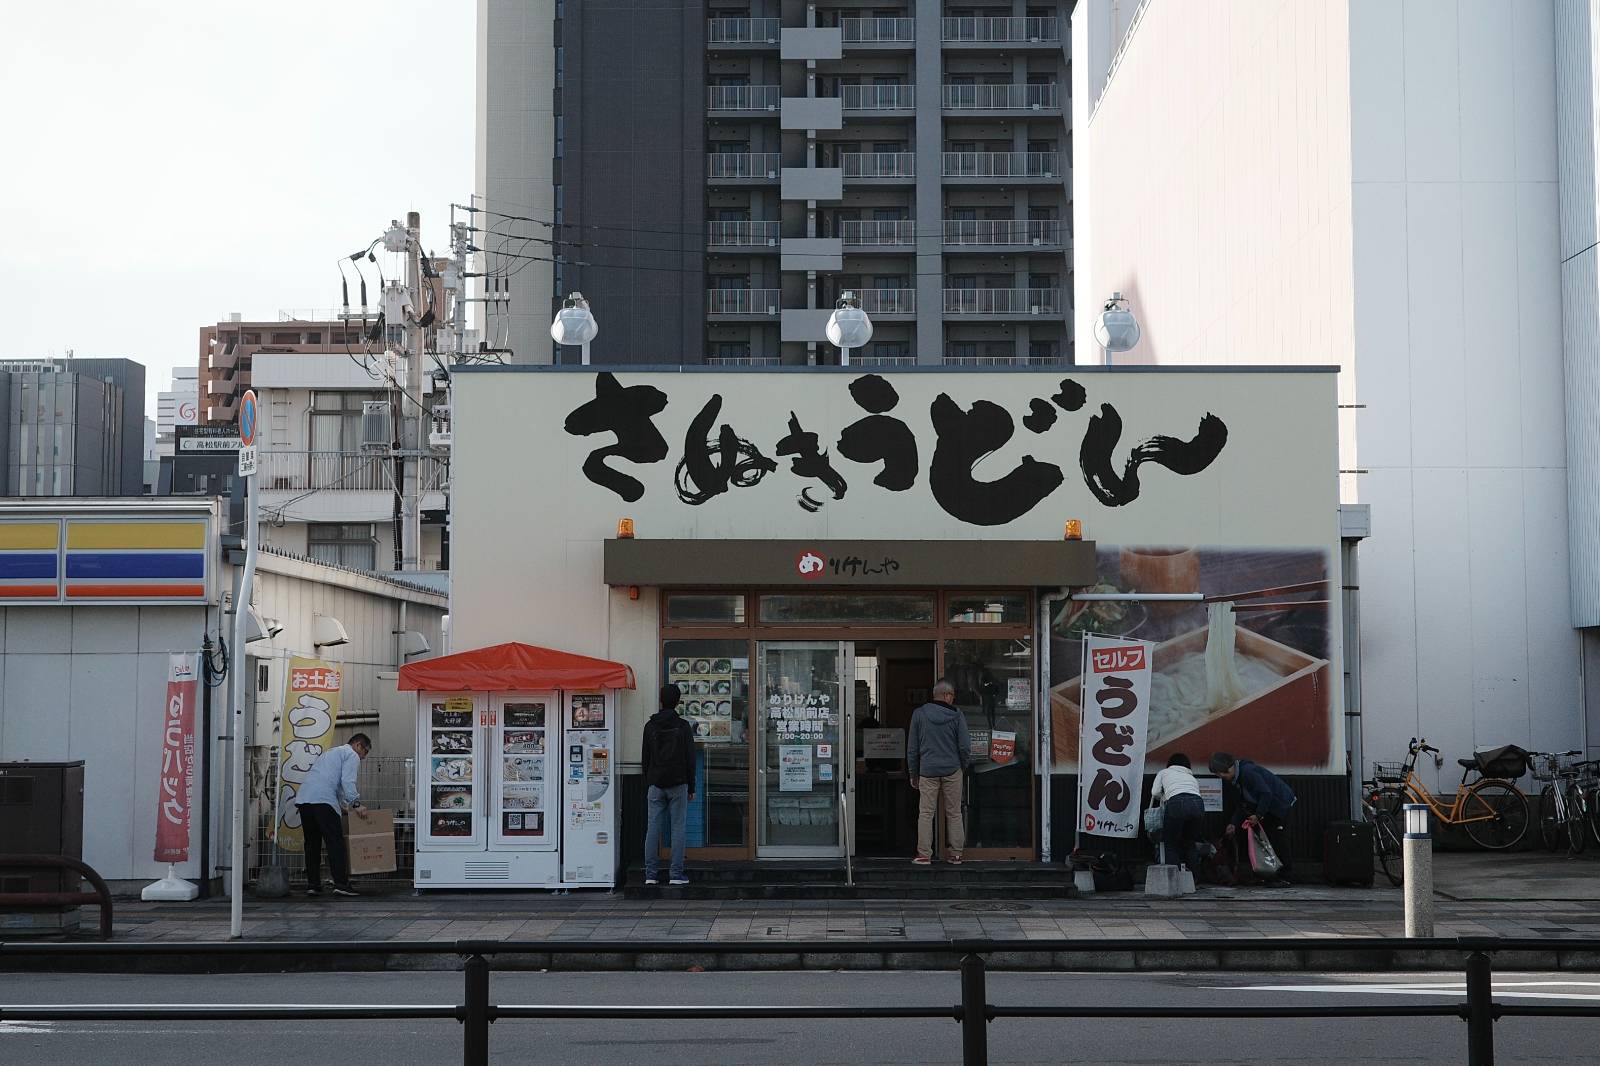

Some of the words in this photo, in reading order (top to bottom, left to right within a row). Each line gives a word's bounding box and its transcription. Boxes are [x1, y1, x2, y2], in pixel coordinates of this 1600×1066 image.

[564, 372, 1228, 526] さぬきうどん
[1093, 649, 1143, 669] セルフ
[292, 671, 340, 689] お土産
[769, 693, 830, 705] めりけんや
[769, 706, 830, 719] 高松駅前店
[776, 720, 824, 732] 営業時間
[1087, 675, 1138, 813] うどん
